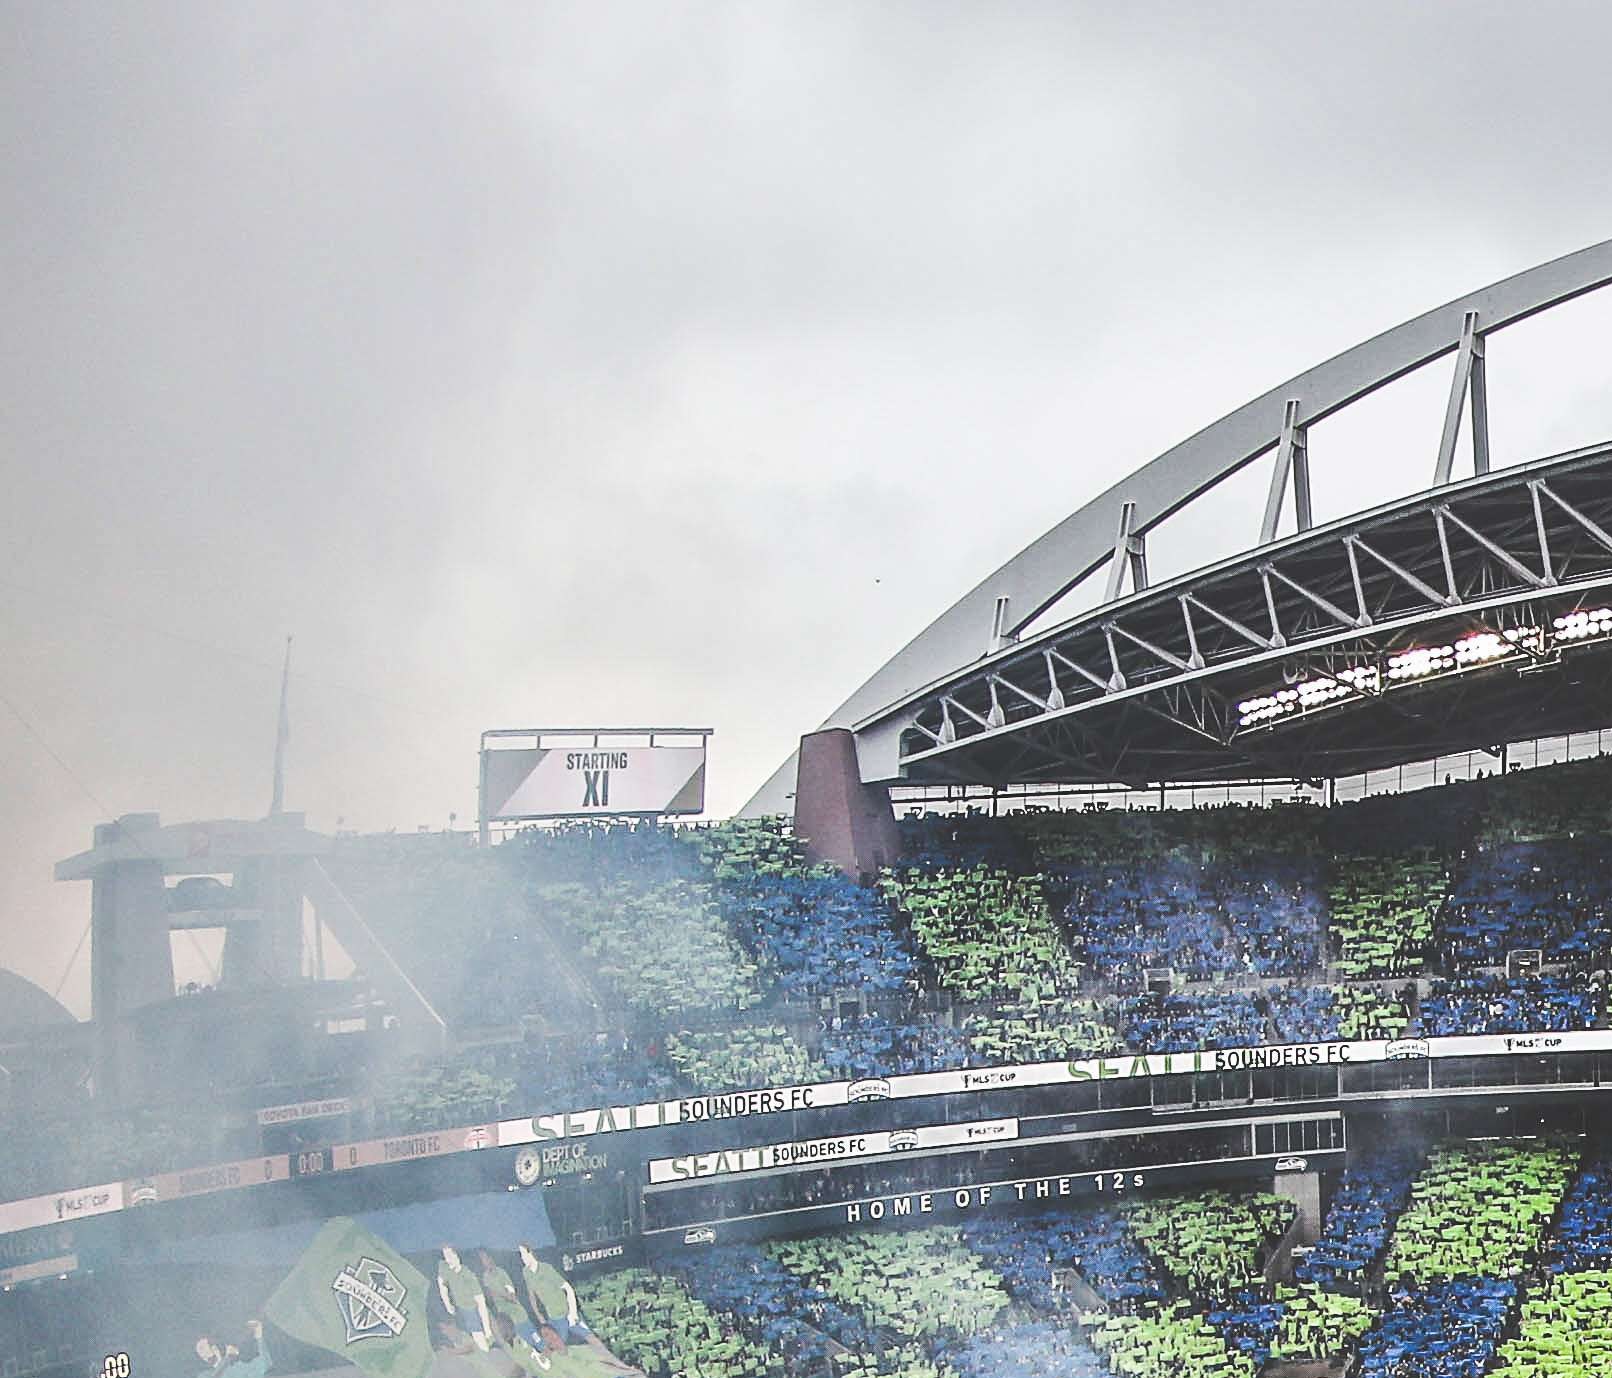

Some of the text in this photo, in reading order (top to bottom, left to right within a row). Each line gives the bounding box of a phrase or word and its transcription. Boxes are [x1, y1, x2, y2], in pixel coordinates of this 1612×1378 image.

[566, 753, 628, 771] STARTING
[583, 771, 609, 807] XI
[1516, 1038, 1562, 1048] MLS CUP
[1215, 1044, 1350, 1070] SOUNDERS FC
[973, 1073, 1016, 1085] MLS CUP
[679, 1088, 814, 1122] SOUNDERS FC
[542, 1142, 587, 1162] DEPT OF
[772, 1139, 866, 1164] SOUNDERS FC
[847, 1174, 1146, 1223] HOME OF THE 12s
[575, 1245, 624, 1263] STARBUCKS
